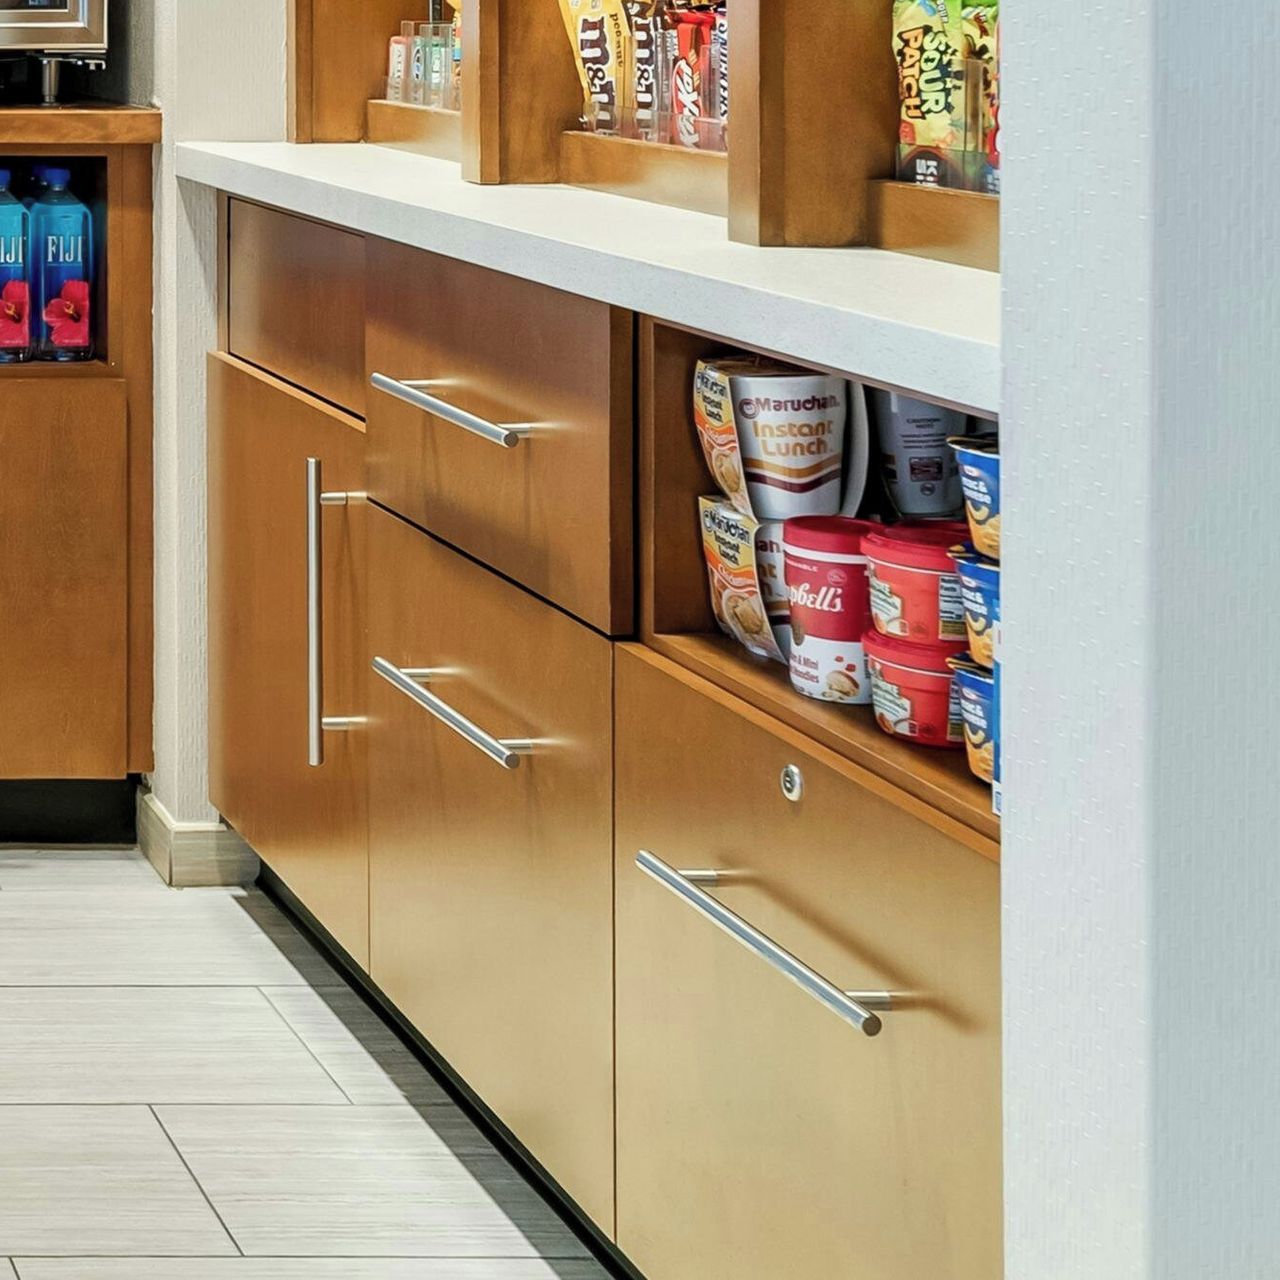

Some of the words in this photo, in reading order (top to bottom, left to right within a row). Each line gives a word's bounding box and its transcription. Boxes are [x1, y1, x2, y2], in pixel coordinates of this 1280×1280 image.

[901, 26, 926, 119] PATCH
[919, 31, 947, 114] SOUR
[46, 236, 83, 262] FIJI
[755, 395, 839, 411] Maruchan
[753, 420, 833, 438] Instant
[761, 438, 831, 458] Lunch
[790, 583, 844, 612] pbell's
